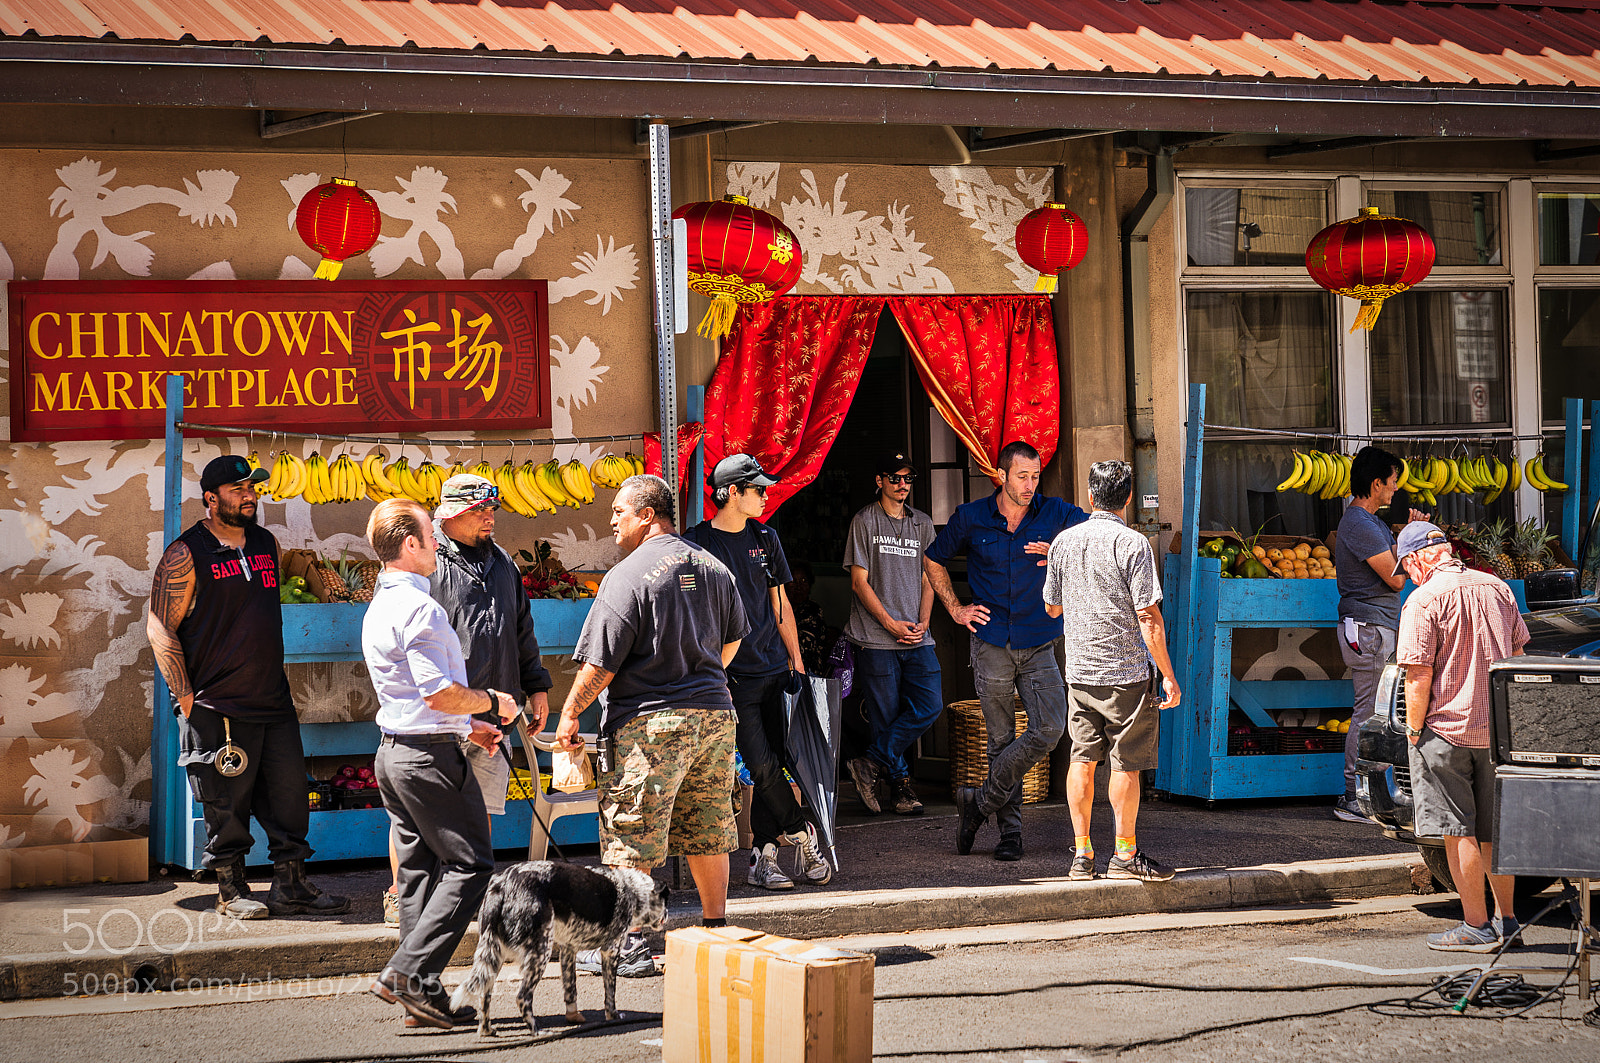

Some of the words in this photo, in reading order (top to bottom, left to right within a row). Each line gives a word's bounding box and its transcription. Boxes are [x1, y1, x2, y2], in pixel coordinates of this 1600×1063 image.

[29, 309, 356, 359] CHINATOWN
[380, 308, 503, 410] 市场
[30, 367, 358, 411] MARKETPLACE
[211, 559, 242, 580] SAIN
[247, 554, 275, 571] LOUIS
[261, 570, 277, 588] 06
